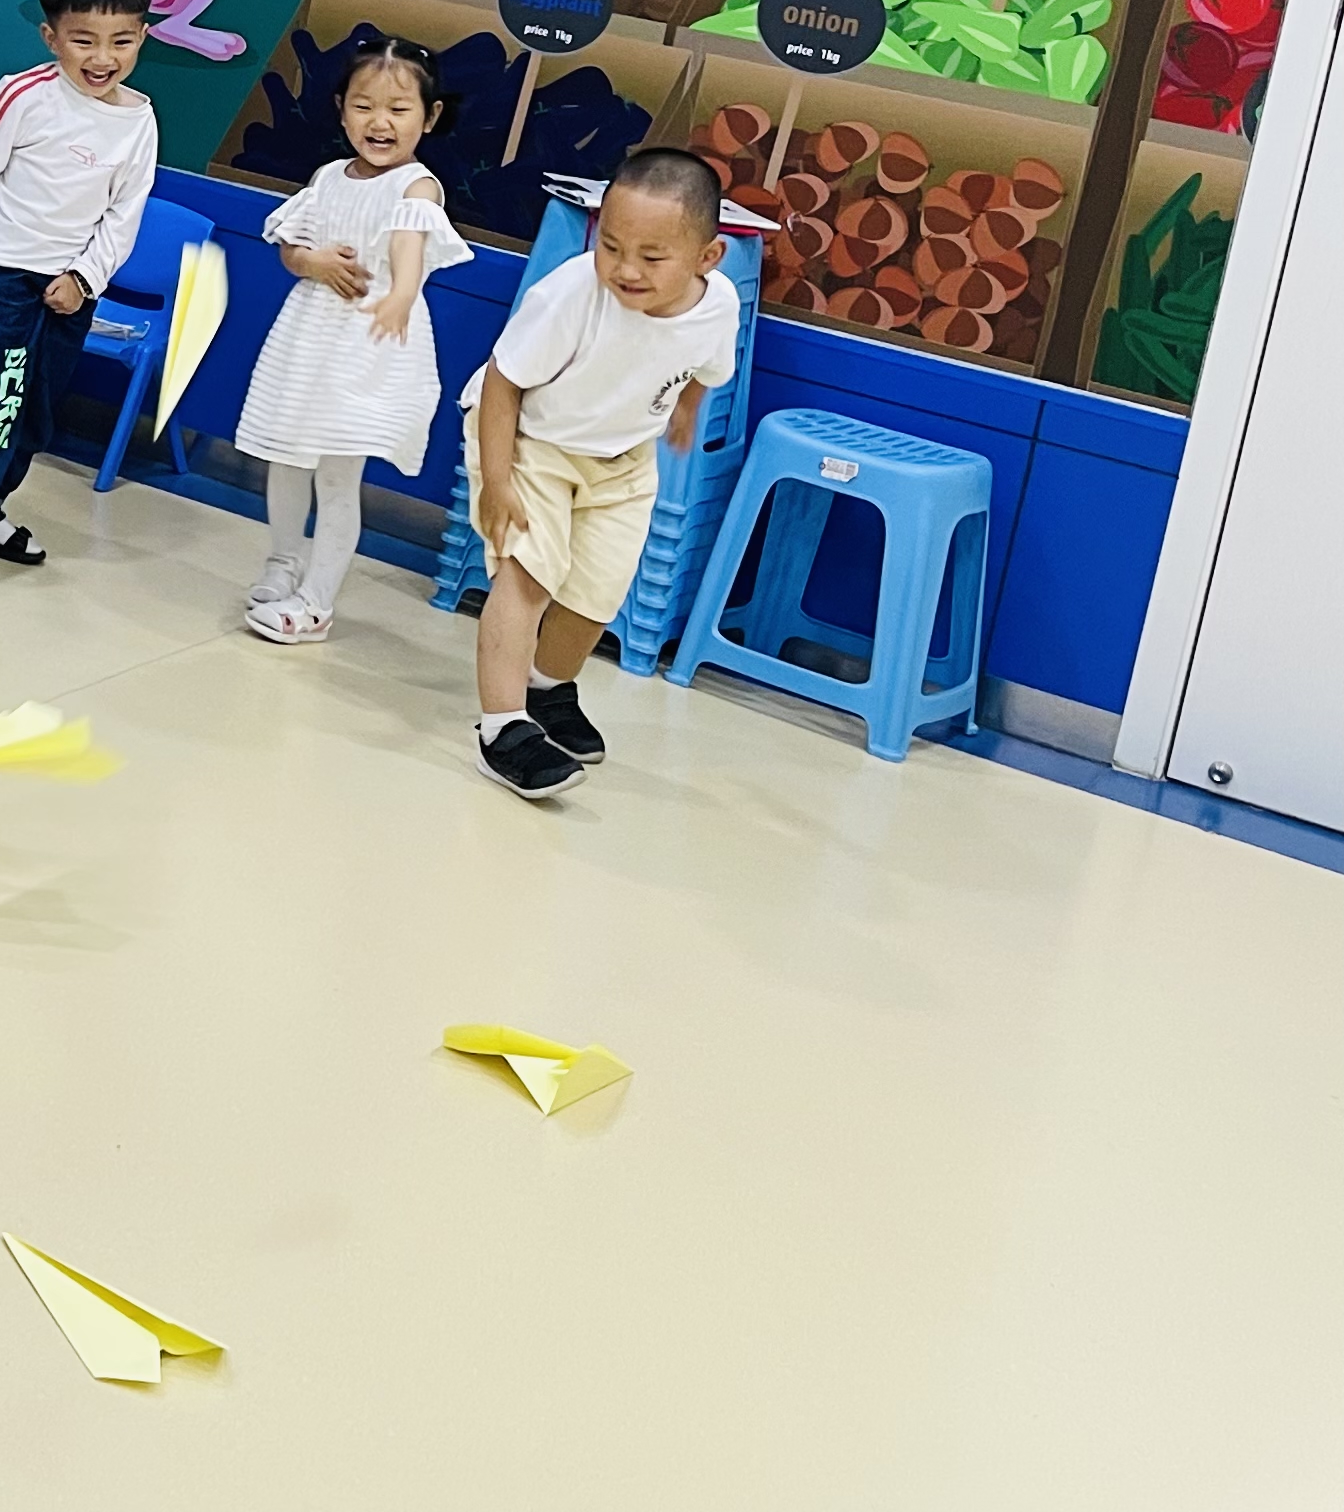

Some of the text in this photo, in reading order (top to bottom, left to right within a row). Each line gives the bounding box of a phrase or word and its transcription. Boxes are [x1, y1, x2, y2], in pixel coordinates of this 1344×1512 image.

[783, 5, 860, 37] onion
[523, 24, 573, 45] price 1kg
[786, 43, 841, 65] price 1kg
